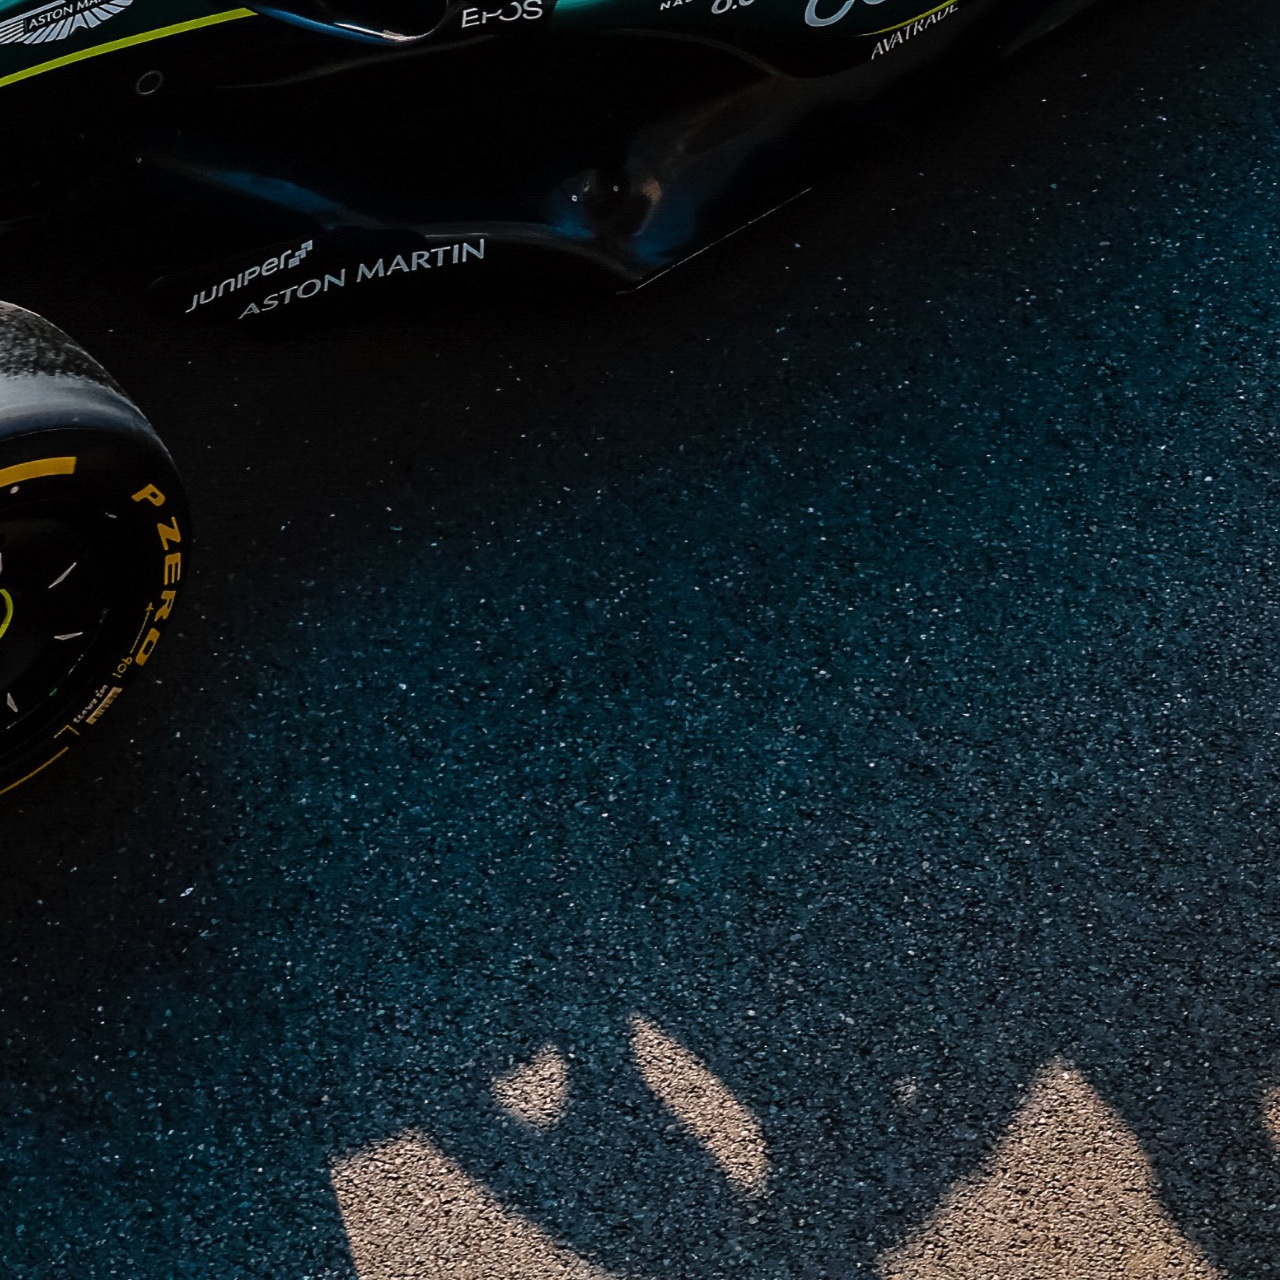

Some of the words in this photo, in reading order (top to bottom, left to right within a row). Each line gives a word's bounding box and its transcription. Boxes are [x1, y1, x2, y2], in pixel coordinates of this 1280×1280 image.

[28, 3, 73, 30] ASTON
[239, 277, 345, 319] ASTON
[356, 239, 485, 282] MARTIN
[132, 483, 165, 506] P
[136, 517, 182, 667] ZERO
